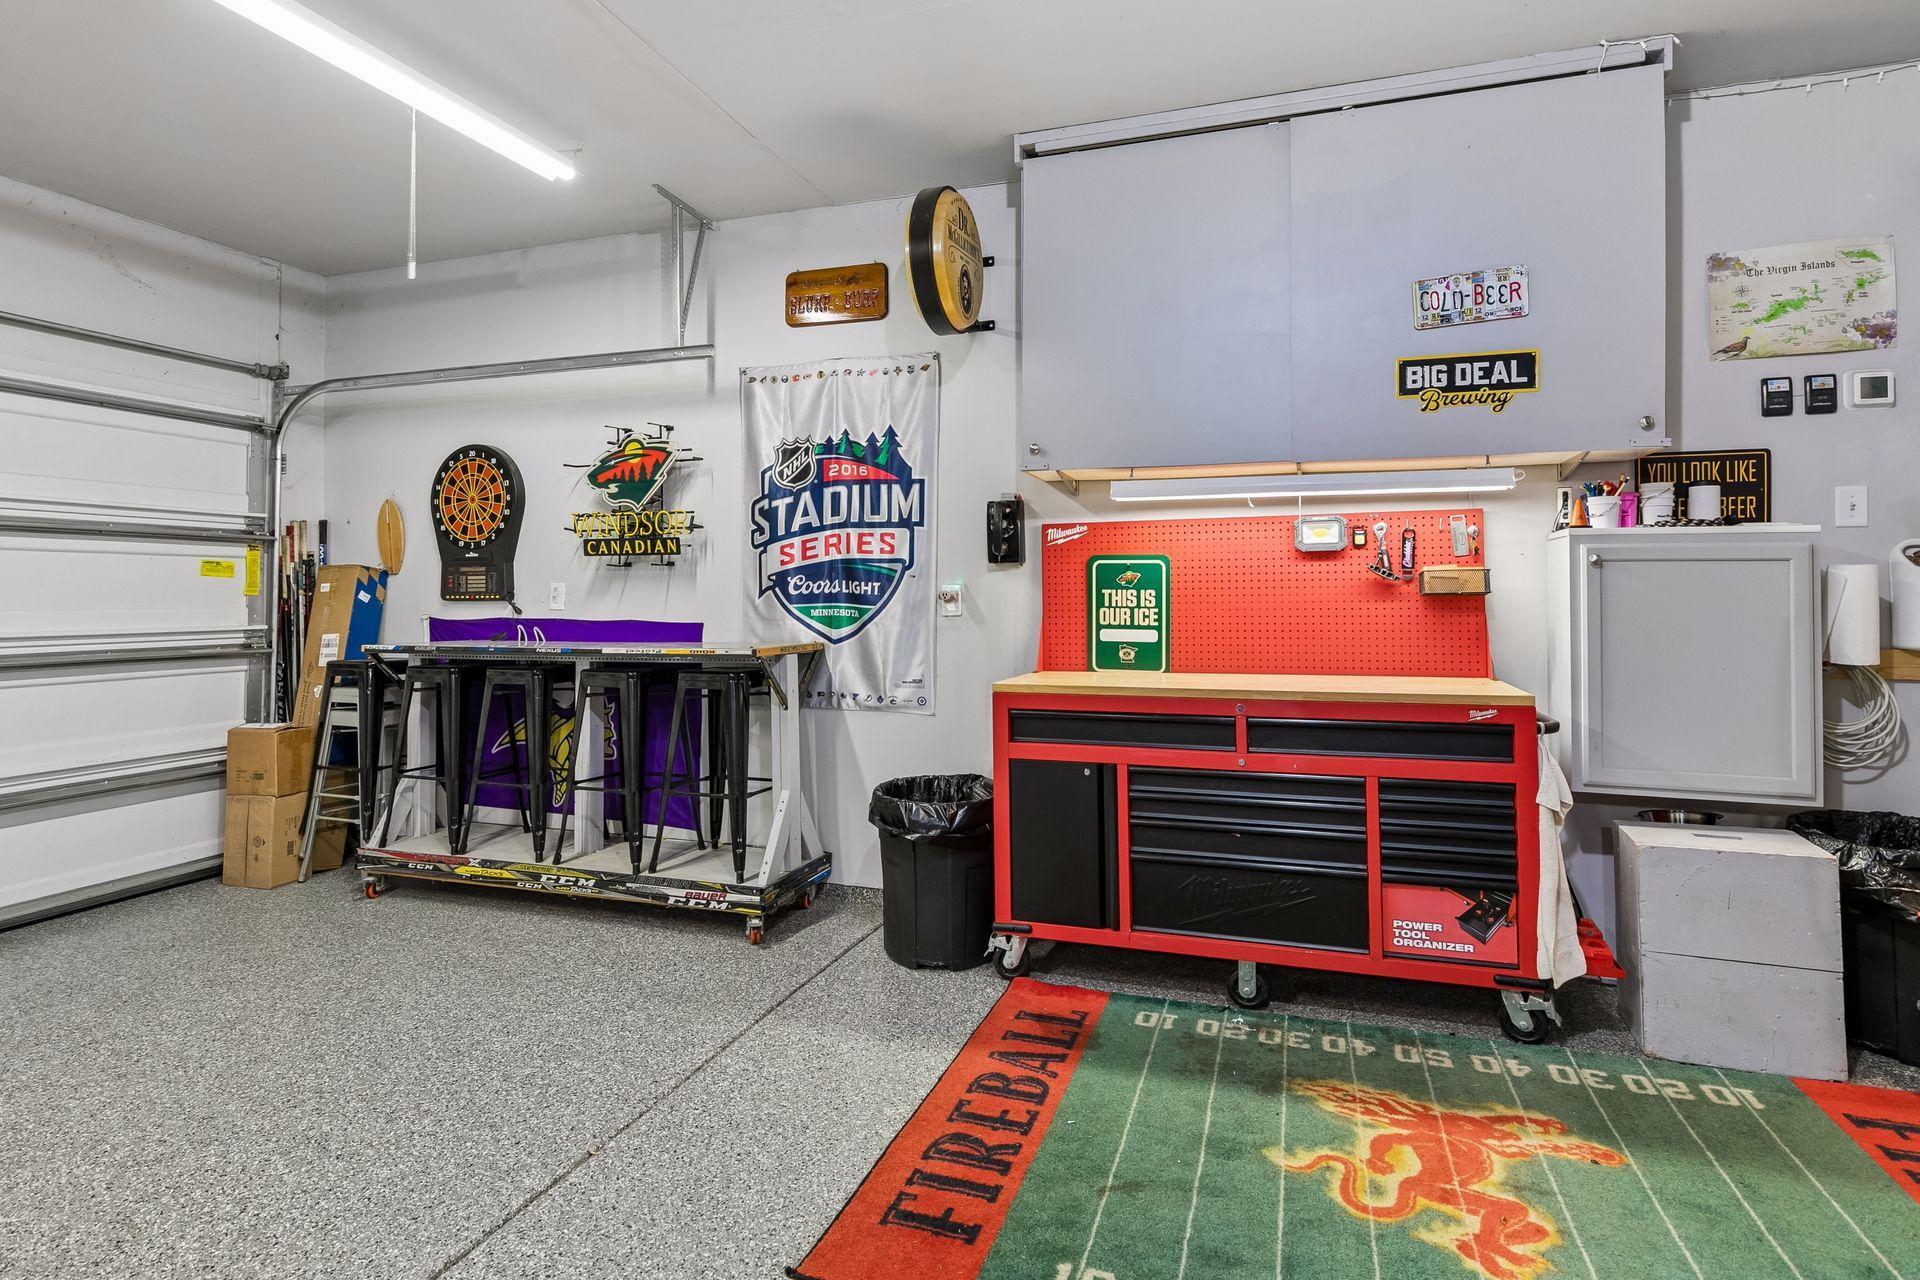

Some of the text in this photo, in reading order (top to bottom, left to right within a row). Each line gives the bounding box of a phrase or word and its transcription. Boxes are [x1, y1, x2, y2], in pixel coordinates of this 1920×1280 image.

[1746, 260, 1836, 278] The Virgin Islands
[1405, 360, 1528, 389] BIG DEAL
[1420, 388, 1513, 413] Brewing
[782, 450, 810, 480] NHL
[828, 464, 868, 477] 2016
[1647, 459, 1757, 484] YOU LOOK LIKE
[753, 483, 920, 542] STADIUM
[571, 508, 689, 538] WINDSOR
[1045, 524, 1088, 541] Milwaukee
[587, 539, 677, 555] CANADIAN
[779, 532, 896, 567] SERIES
[787, 575, 881, 596] Coors LIGHT
[1101, 589, 1156, 608] THIS IS
[810, 608, 860, 618] MINNESOTA
[1099, 608, 1159, 626] OUR ICE
[408, 862, 434, 870] CCM
[539, 874, 596, 887] CCM
[667, 896, 729, 910] CCM
[684, 891, 728, 901] BAUER
[1392, 919, 1443, 932] POWER
[1392, 929, 1430, 941] TOOL
[1392, 937, 1474, 953] ORGANIZER
[1134, 1010, 1178, 1030] 10
[1196, 1019, 1248, 1039] 20
[1257, 1027, 1311, 1049] 30
[1321, 1036, 1376, 1056] 40
[1394, 1044, 1454, 1068] 50
[1469, 1055, 1533, 1078] 40
[1547, 1065, 1616, 1090] 30
[1621, 1074, 1697, 1101] 20
[1699, 1084, 1766, 1109] 10
[879, 1009, 1090, 1245] FIREBALL
